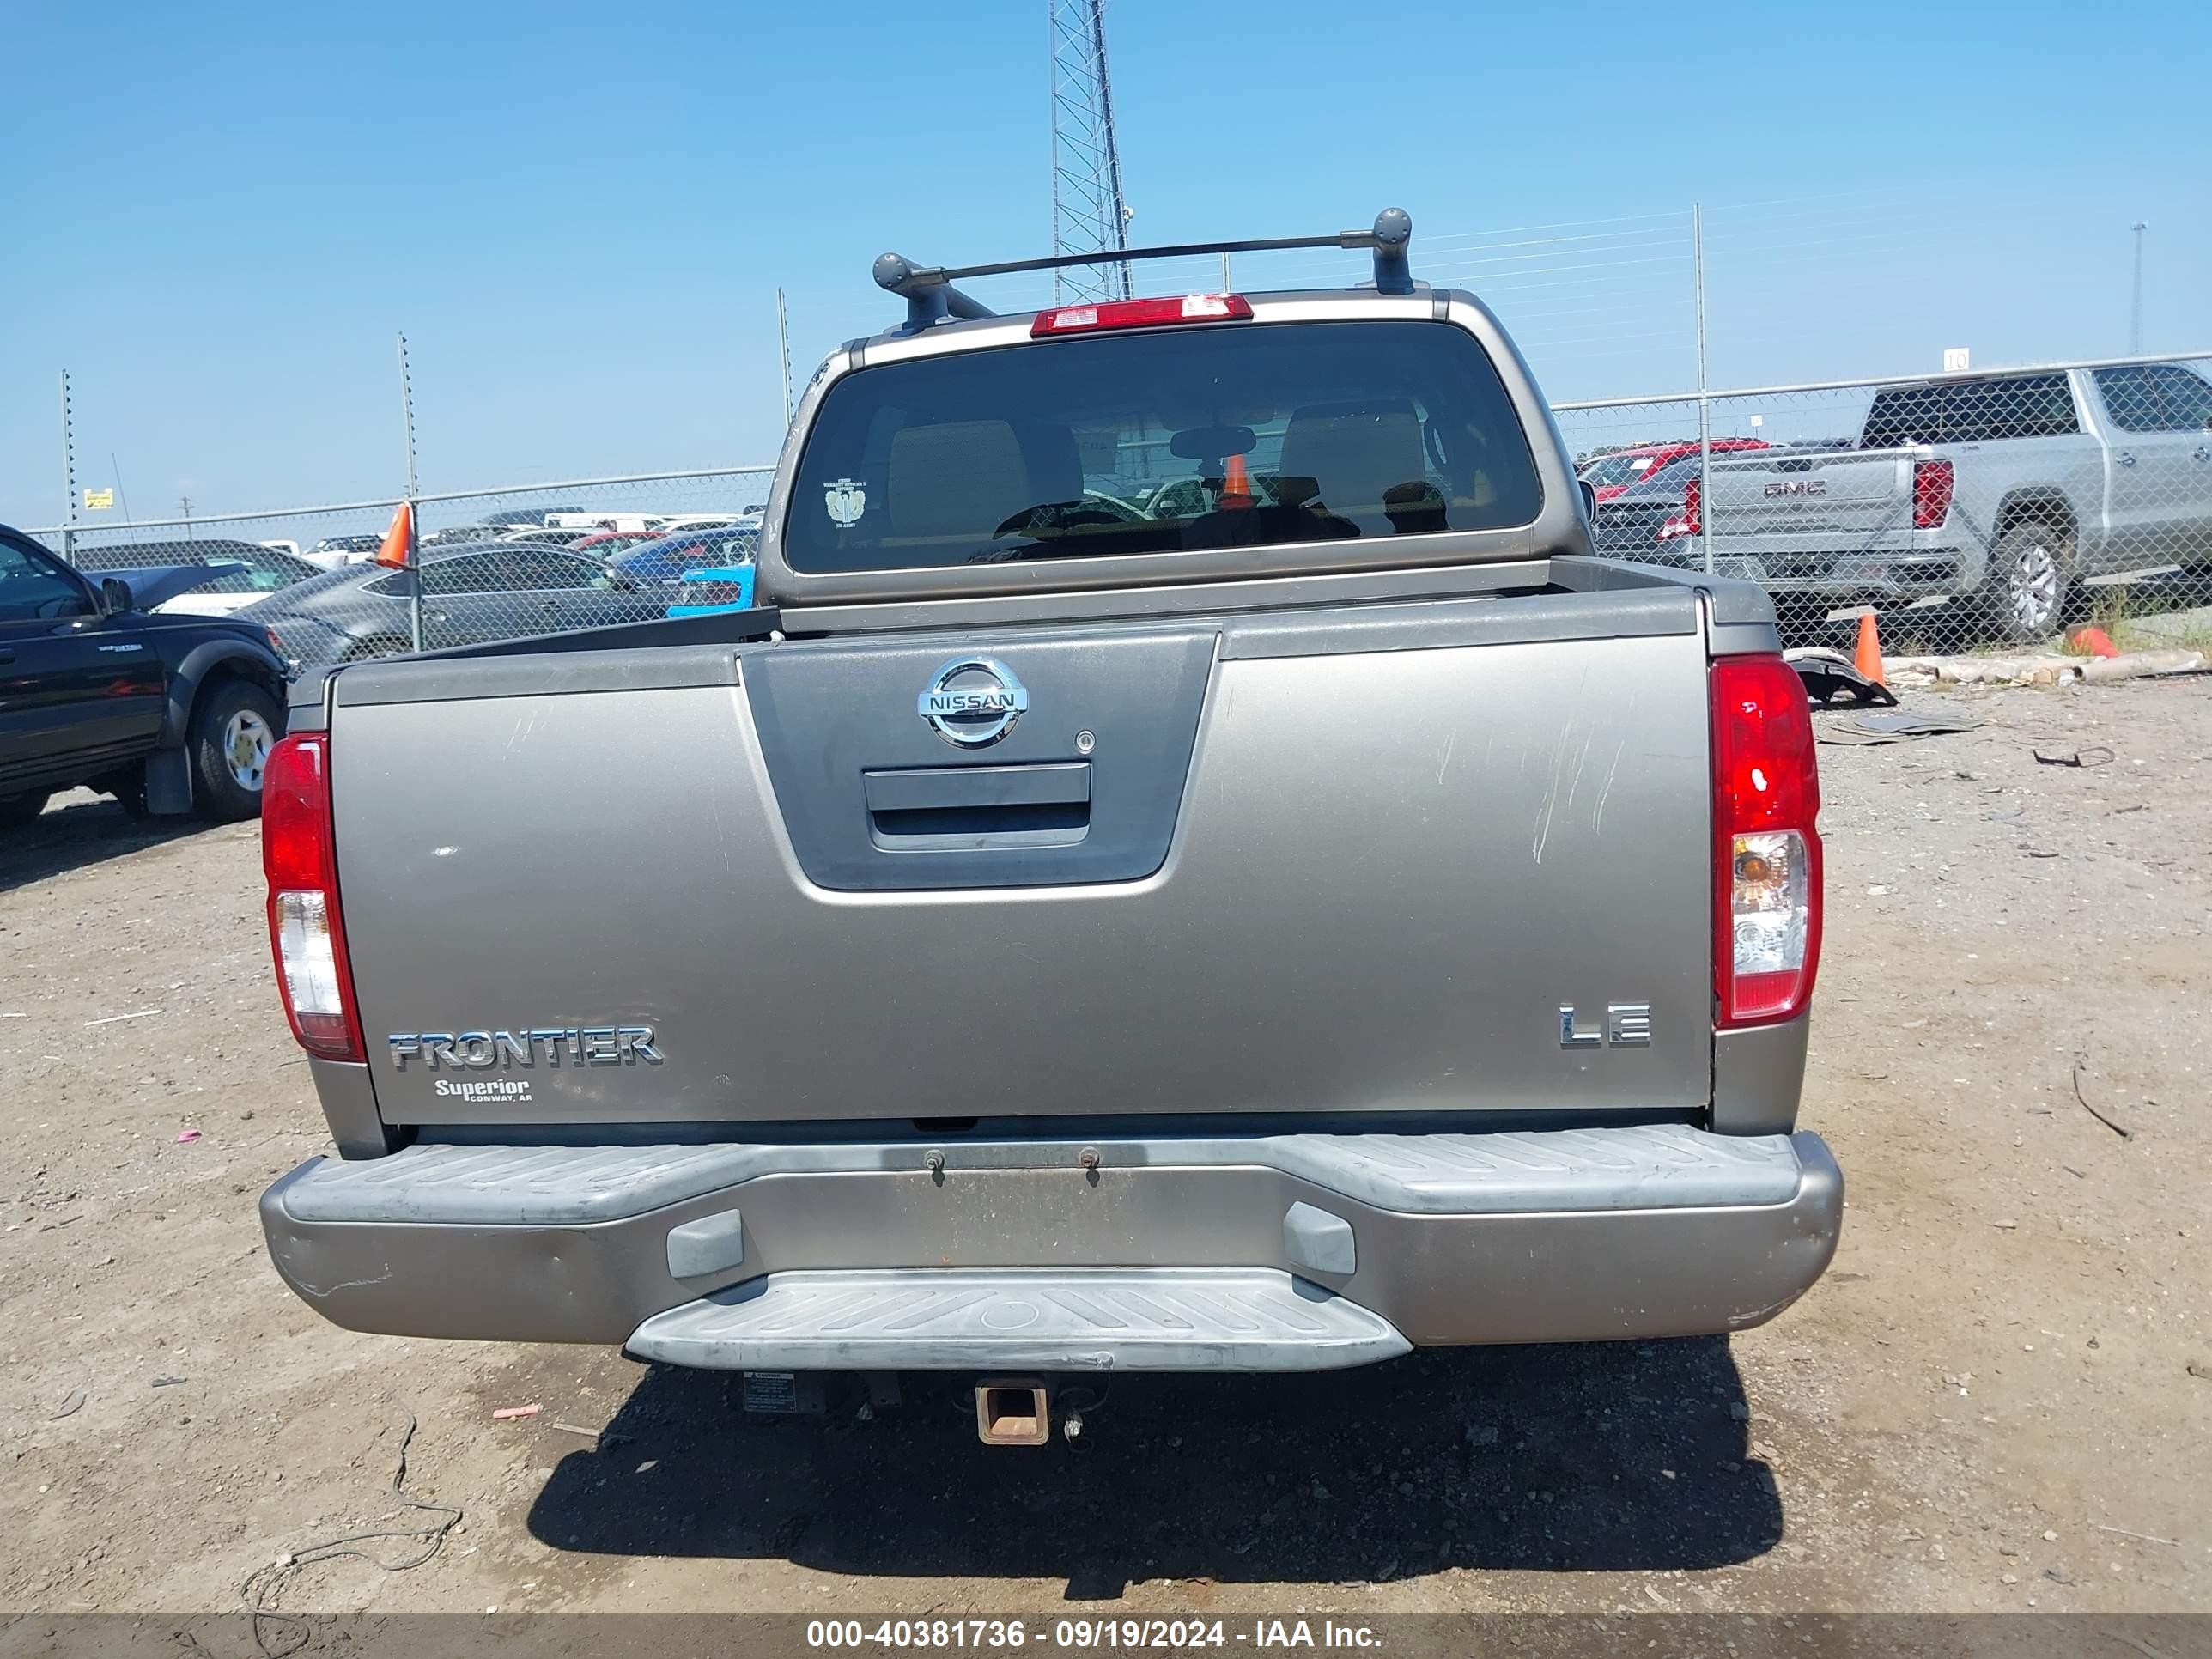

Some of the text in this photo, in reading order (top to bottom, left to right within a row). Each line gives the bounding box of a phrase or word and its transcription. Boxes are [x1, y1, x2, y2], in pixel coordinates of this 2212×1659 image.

[1946, 353, 1966, 369] 10
[1765, 480, 1827, 496] GMC
[930, 693, 1014, 711] NISSAN
[1559, 1003, 1650, 1046] LE
[388, 1025, 665, 1068] FRONTIER
[434, 1078, 530, 1102] Superior
[470, 1094, 516, 1103] CONWAY,
